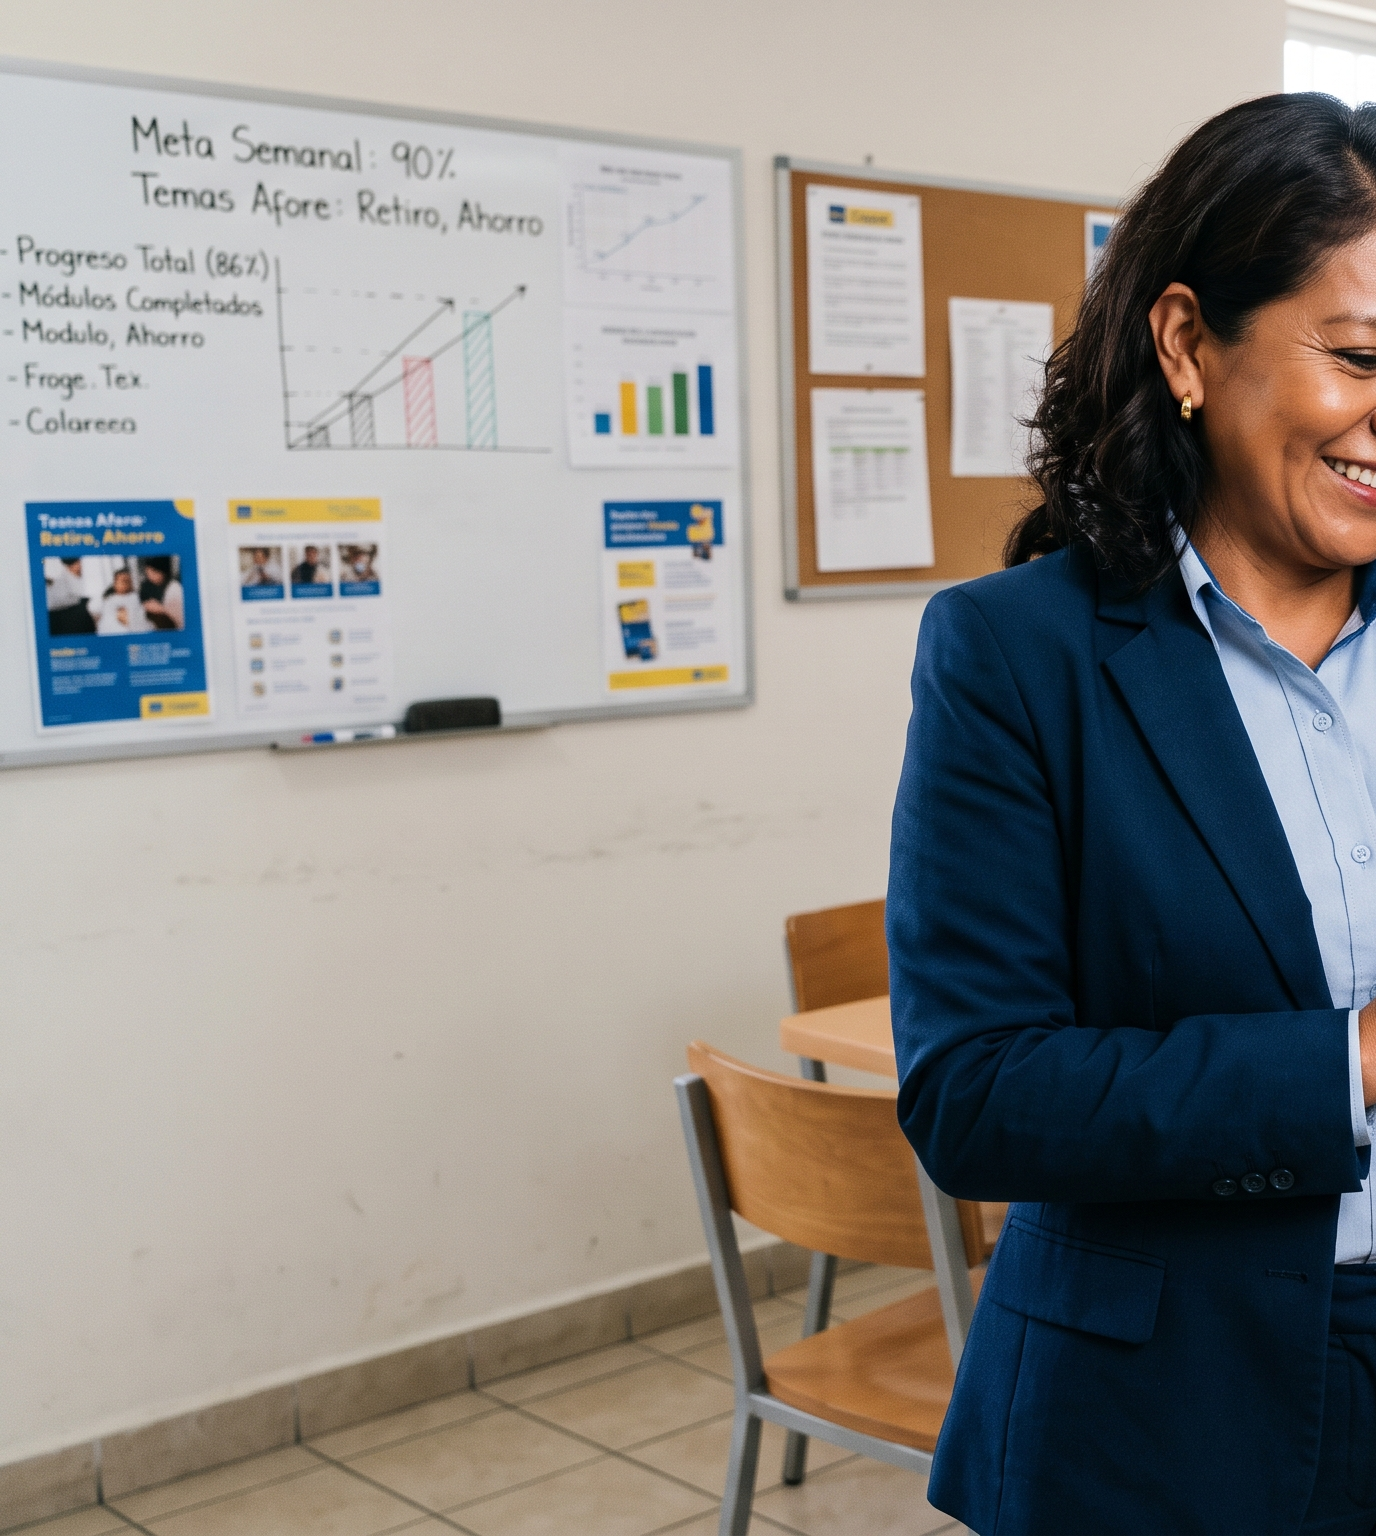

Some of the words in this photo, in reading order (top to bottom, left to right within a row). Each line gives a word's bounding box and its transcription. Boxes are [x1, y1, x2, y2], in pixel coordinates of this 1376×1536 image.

[131, 115, 216, 160] Meta
[391, 140, 456, 180] 90%
[131, 171, 235, 213] Temas
[357, 188, 448, 235] Retiro,
[457, 199, 544, 237] Ahorro
[17, 234, 127, 277] Progreso
[135, 245, 195, 274] Total
[206, 247, 270, 282] (86%)
[19, 282, 117, 311] Módulos
[126, 286, 264, 319] Completados
[22, 319, 116, 350] Modulo,
[126, 323, 205, 348] Ahorro
